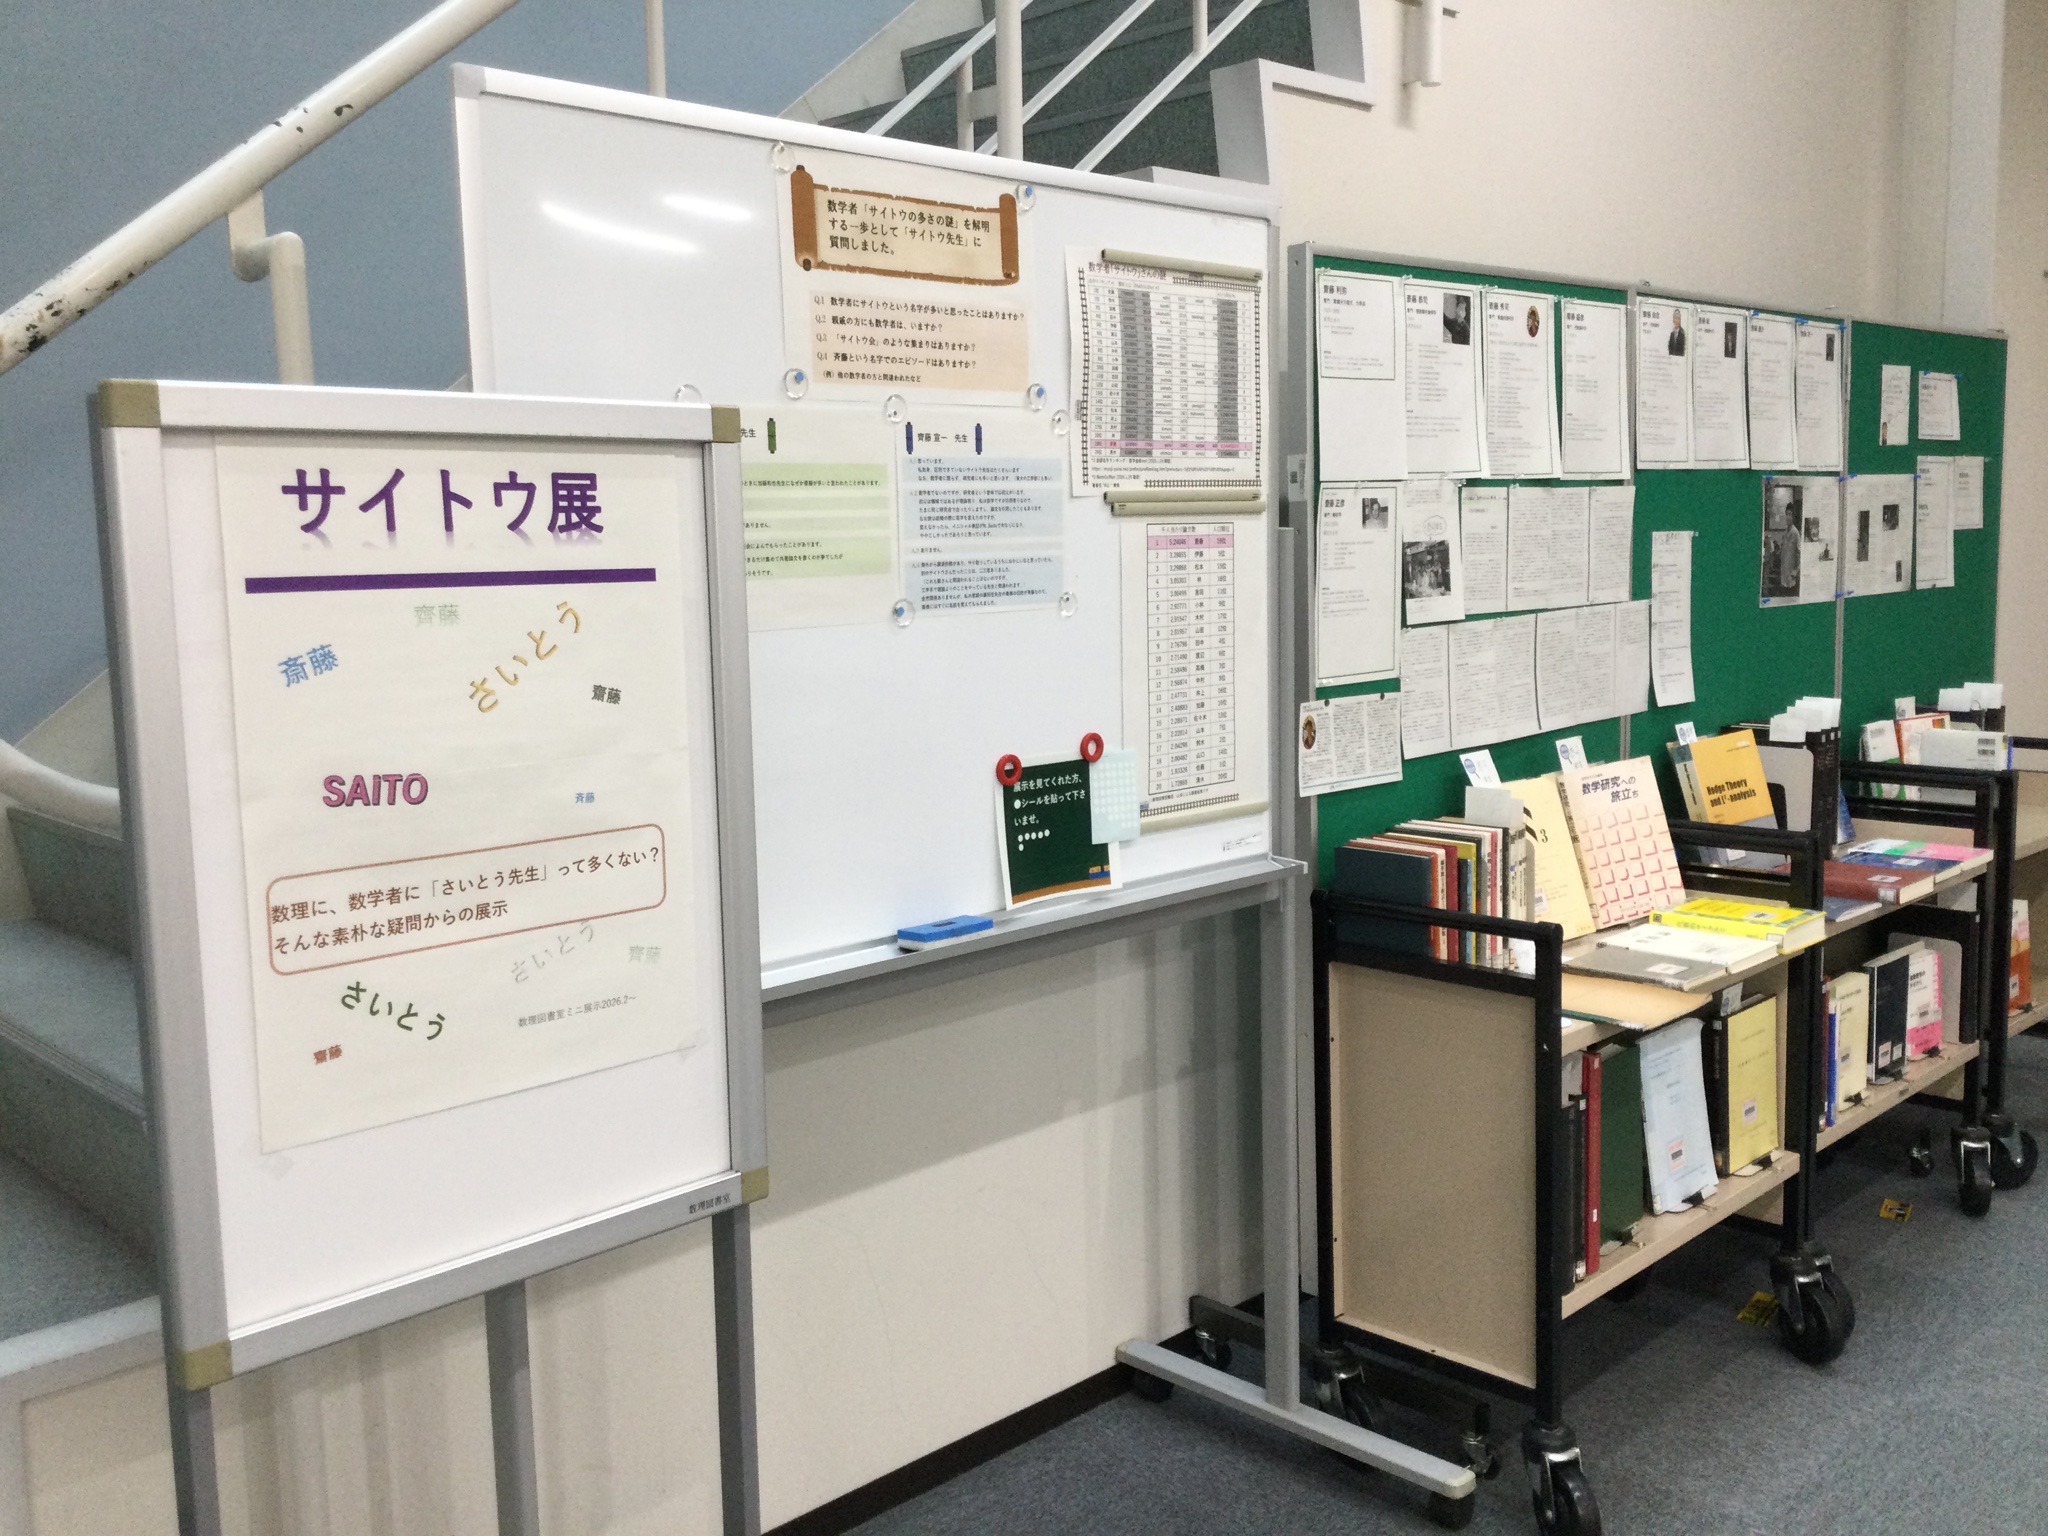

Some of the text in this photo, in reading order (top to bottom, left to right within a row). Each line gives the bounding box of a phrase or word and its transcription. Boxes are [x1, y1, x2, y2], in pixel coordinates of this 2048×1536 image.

[826, 199, 991, 233] 数学者「サイトウの多さの謎」を解明
[828, 217, 982, 248] する一歩として「サイトウ先生」に
[829, 235, 896, 256] 質問しました。
[954, 434, 968, 443] 先生
[282, 468, 604, 535] サイトウ展
[469, 600, 583, 712] さいとう
[323, 772, 428, 807] SAITO
[1013, 774, 1082, 792] 展示を見てくれた方、
[1582, 776, 1636, 796] 数学研究への
[1611, 788, 1640, 803] 旅立ち
[1725, 778, 1748, 792] Theory
[1710, 797, 1721, 808] and
[1014, 814, 1039, 826] いませ。
[1540, 828, 1549, 844] 3
[270, 846, 660, 926] 数理に、数学者に「さいとう先生」って多くない？
[273, 900, 509, 955] そんな素朴な疑問からの展示
[511, 920, 597, 984] さいとう
[340, 980, 447, 1042] さいとう
